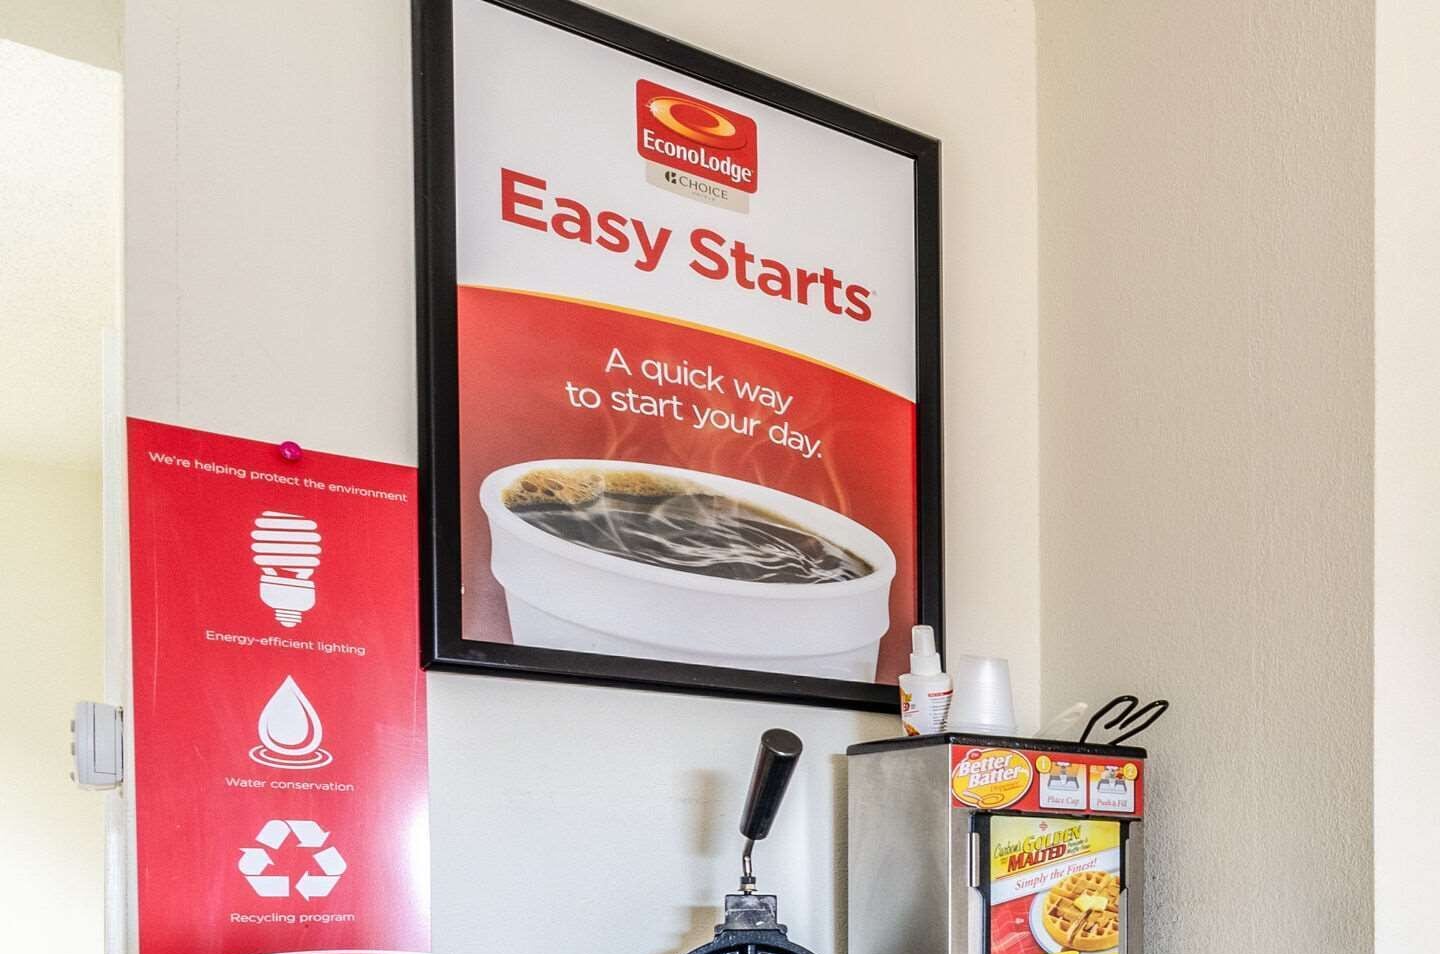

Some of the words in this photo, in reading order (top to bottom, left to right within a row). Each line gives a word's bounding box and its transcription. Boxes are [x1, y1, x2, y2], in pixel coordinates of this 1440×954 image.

[643, 128, 752, 183] EconoLodge
[679, 176, 729, 200] CHOICE
[501, 168, 672, 273] Easy
[689, 228, 873, 322] Starts
[605, 348, 632, 376] A
[641, 359, 725, 394] quick
[733, 378, 793, 415] way
[565, 381, 601, 409] to
[611, 388, 683, 421] start
[692, 404, 761, 436] your
[768, 422, 822, 459] day.
[149, 451, 191, 468] We're
[194, 459, 246, 479] helping
[250, 470, 300, 487] protect
[303, 477, 325, 490] the
[329, 481, 408, 502] environment
[205, 630, 314, 650] Energy-efficient
[318, 641, 366, 656] lighting
[959, 754, 1013, 777] Better
[225, 777, 266, 789] Water
[270, 779, 354, 792] conservation
[1022, 825, 1081, 853] GOLDEN
[1008, 844, 1067, 872] MALTED
[1015, 872, 1048, 890] Simply
[1050, 867, 1064, 880] the
[230, 912, 295, 923] Recycling
[300, 912, 355, 923] program
